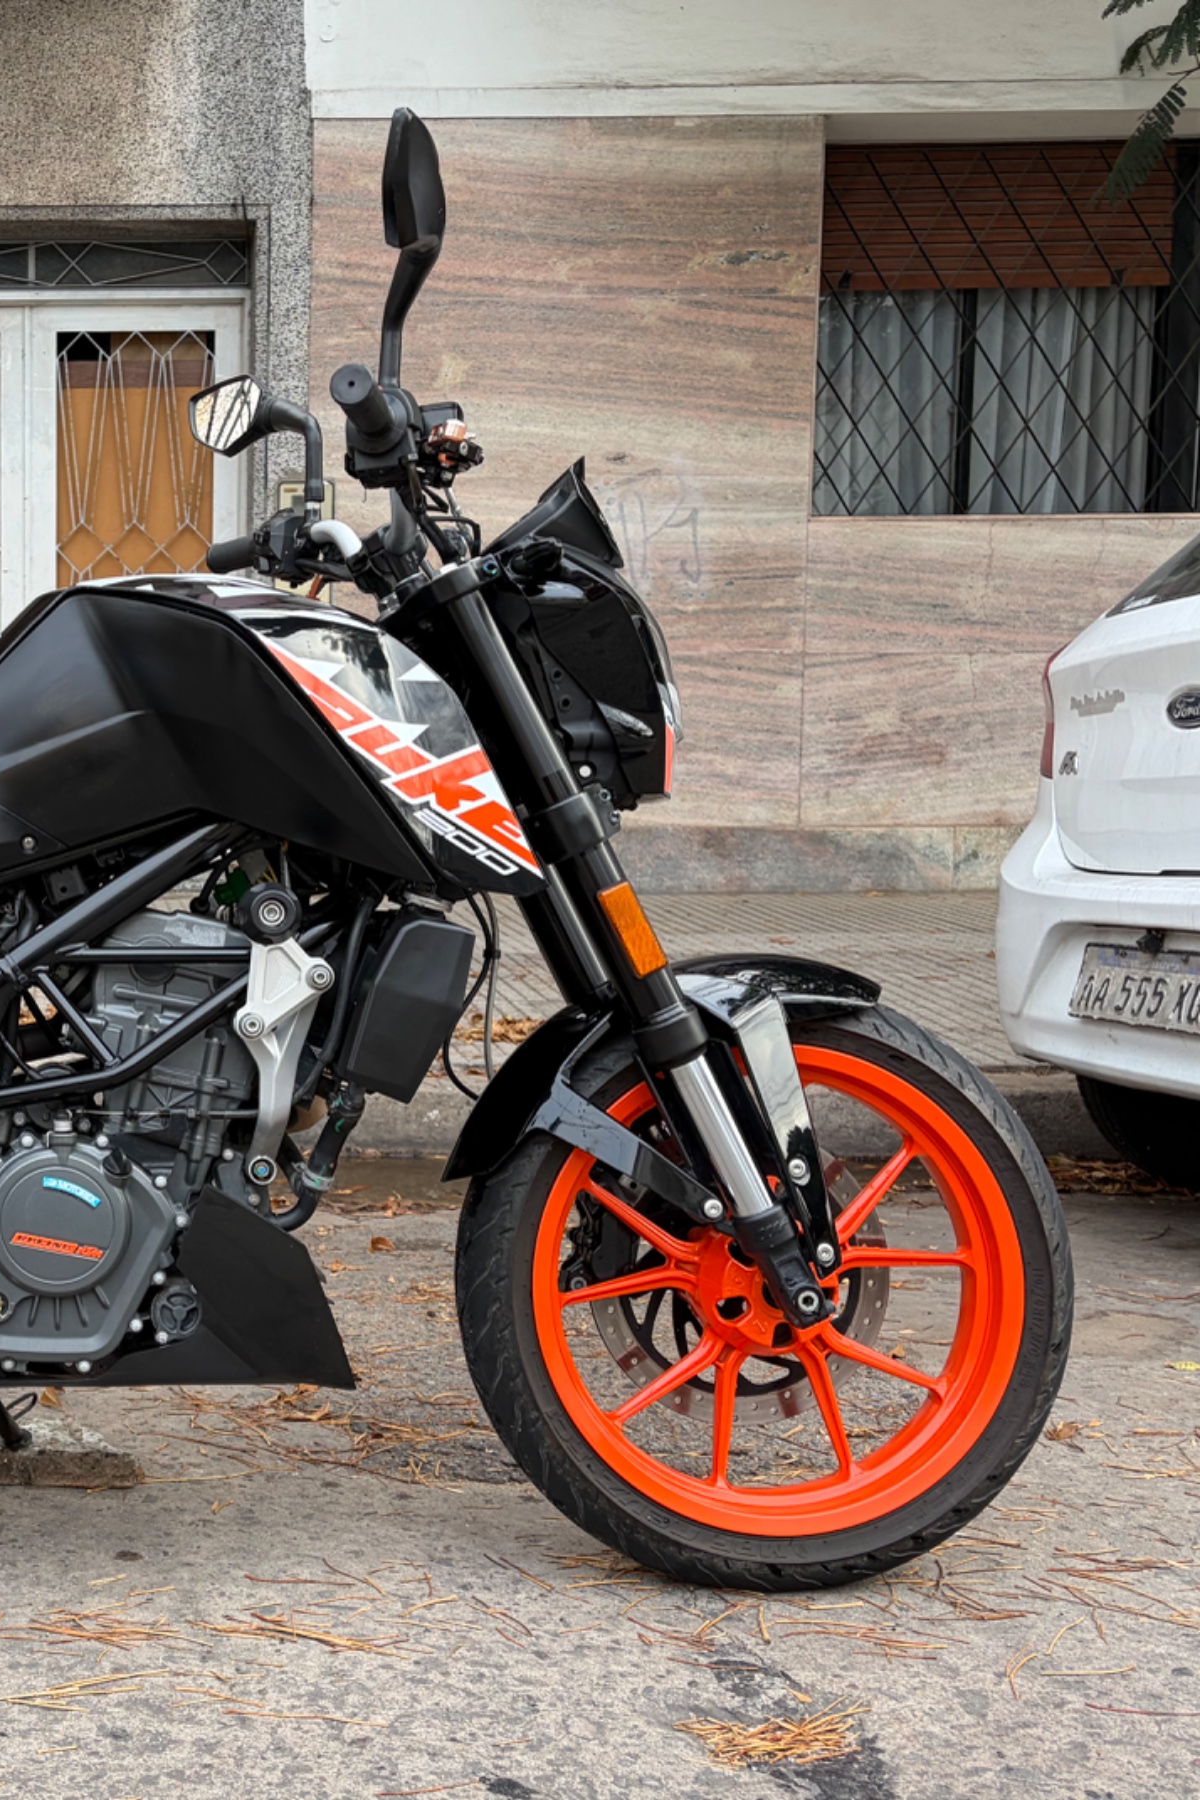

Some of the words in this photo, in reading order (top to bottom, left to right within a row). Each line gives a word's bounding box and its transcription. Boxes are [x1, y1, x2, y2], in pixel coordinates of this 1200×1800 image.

[266, 641, 541, 870] DUKE
[413, 810, 519, 876] 200
[1077, 975, 1110, 1012] AA
[1114, 974, 1167, 1018] 555
